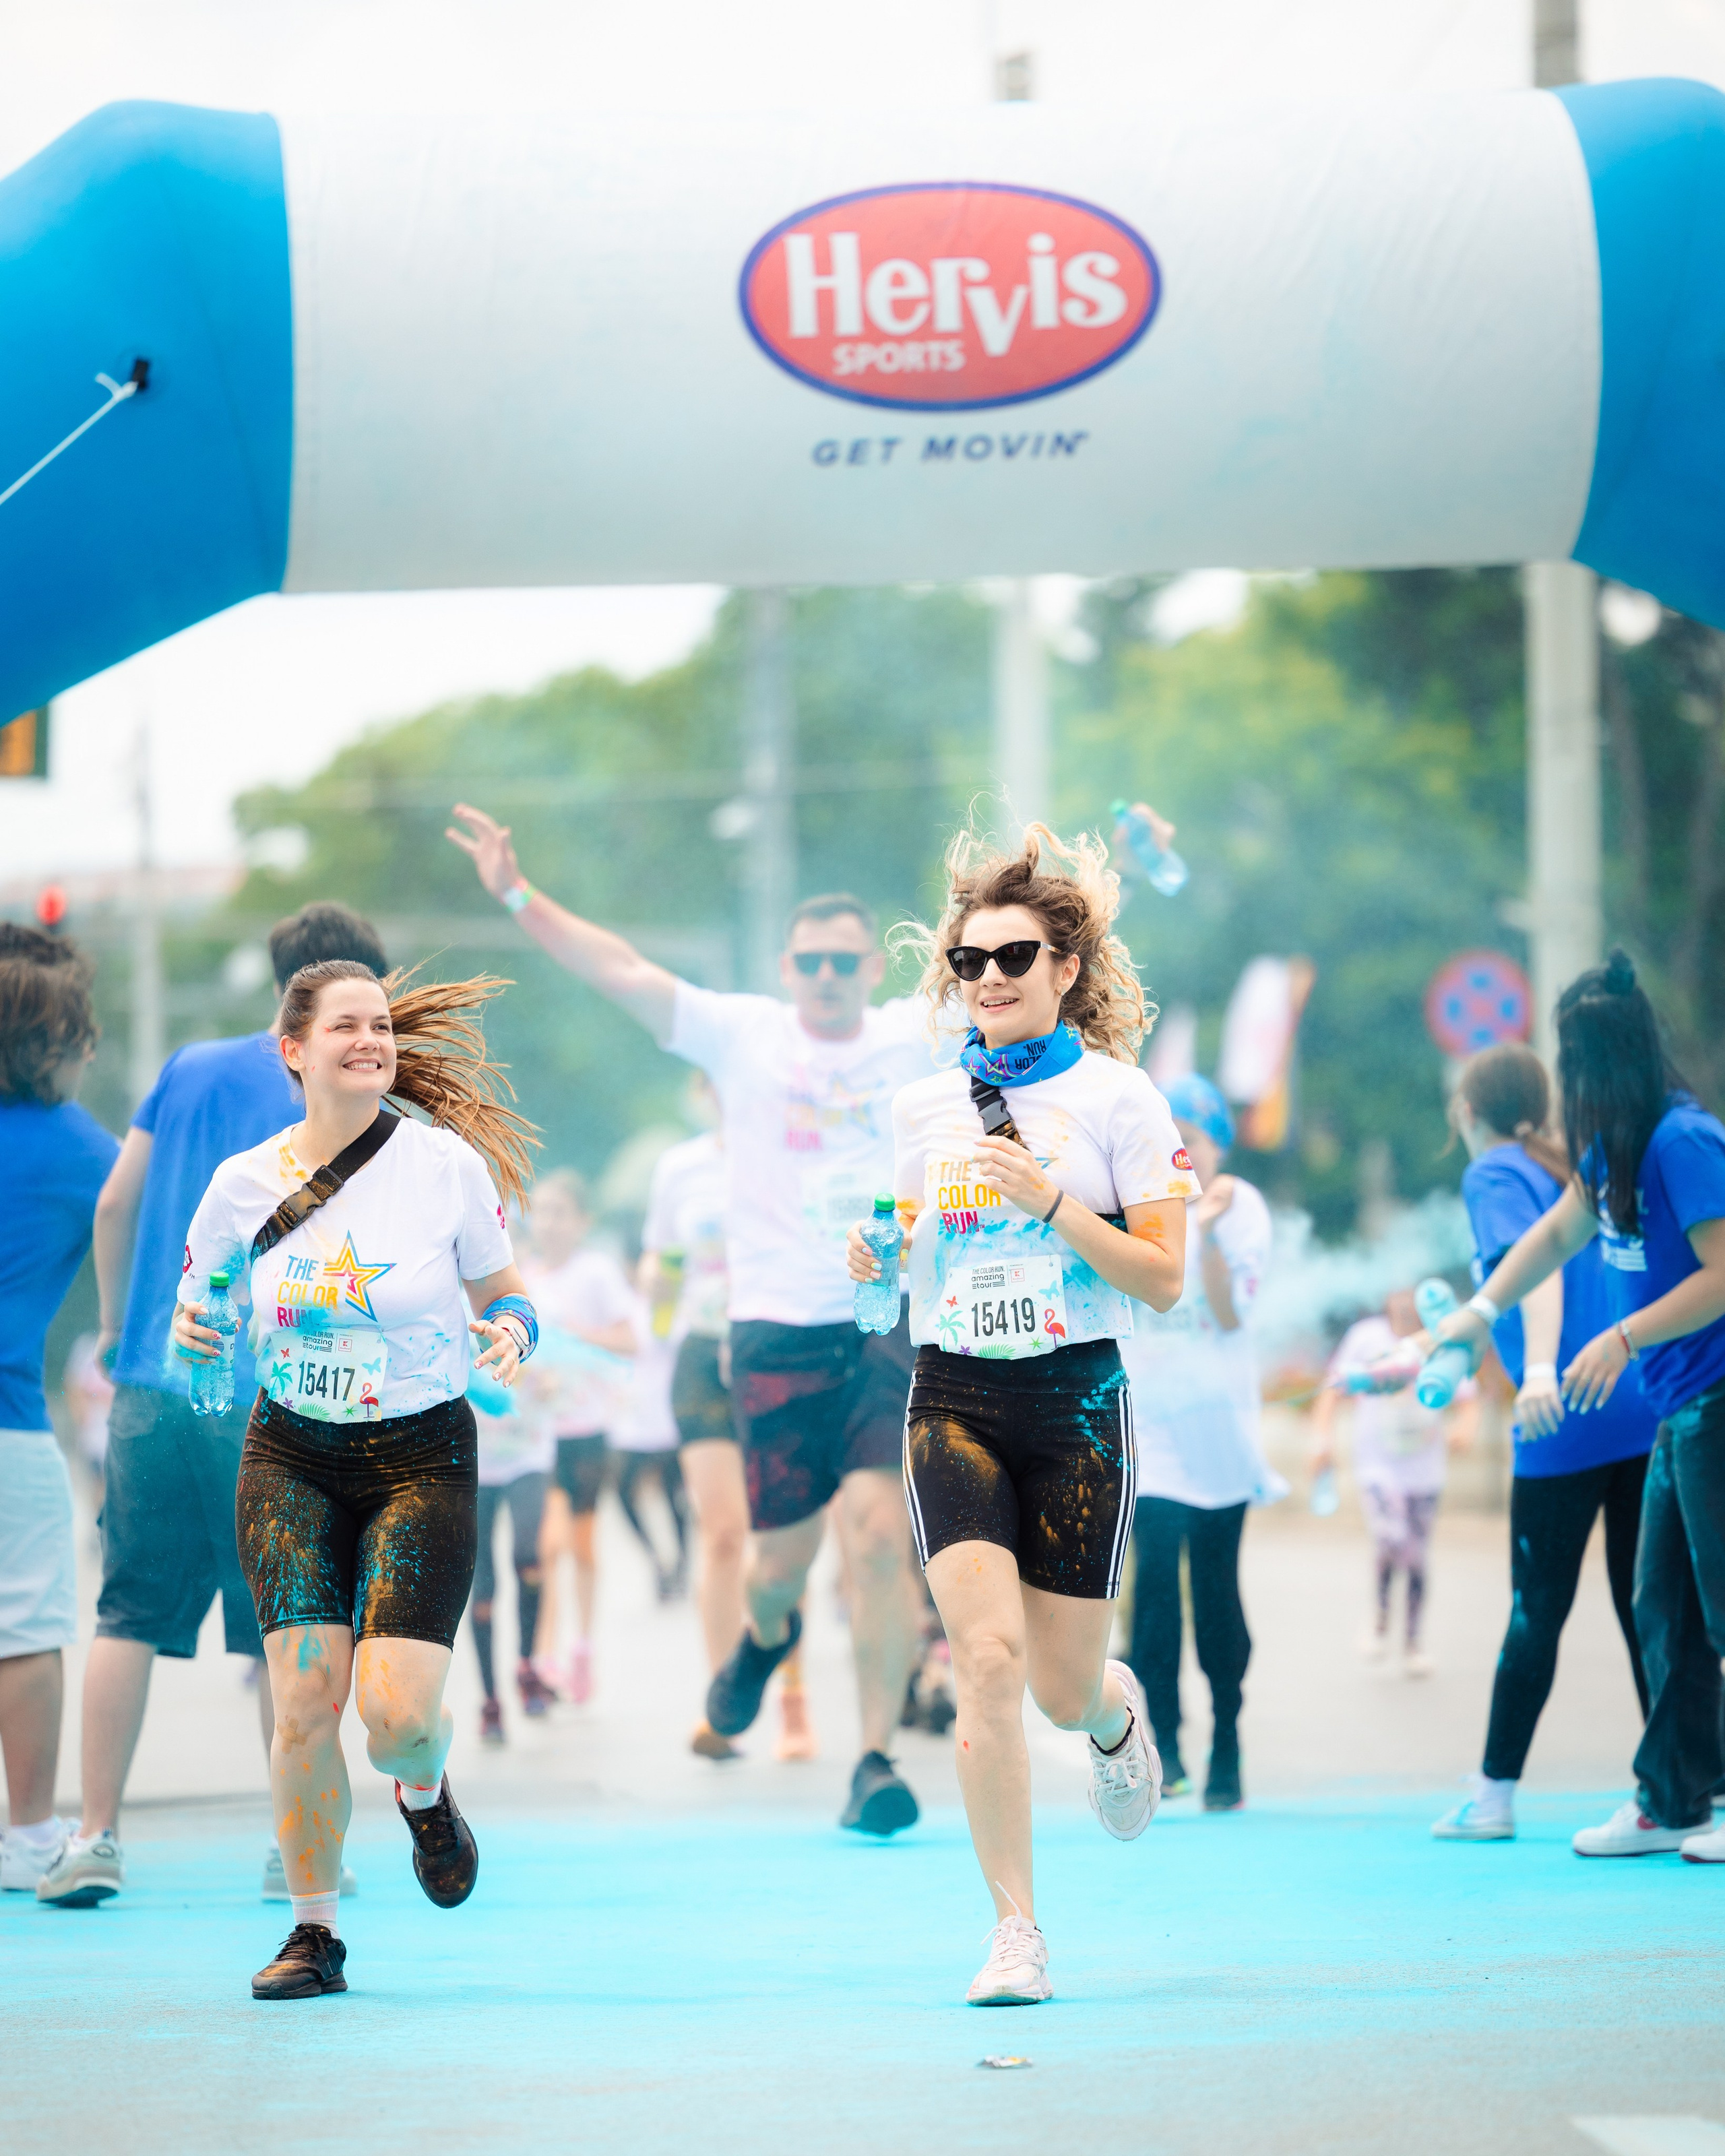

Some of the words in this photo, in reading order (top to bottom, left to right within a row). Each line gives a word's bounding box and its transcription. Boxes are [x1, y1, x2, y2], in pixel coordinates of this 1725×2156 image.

[784, 232, 1128, 356] Hervis
[832, 340, 966, 375] SPORTS
[813, 436, 902, 466] GET
[940, 1161, 972, 1183] THE
[938, 1184, 1001, 1210] COLOR
[286, 1255, 319, 1281] THE
[972, 1273, 1005, 1281] amazing
[277, 1281, 338, 1310] COLOR
[971, 1298, 1036, 1337] 15419
[303, 1335, 333, 1348] amazing
[306, 1342, 319, 1351] tour
[298, 1361, 355, 1401] 15417
